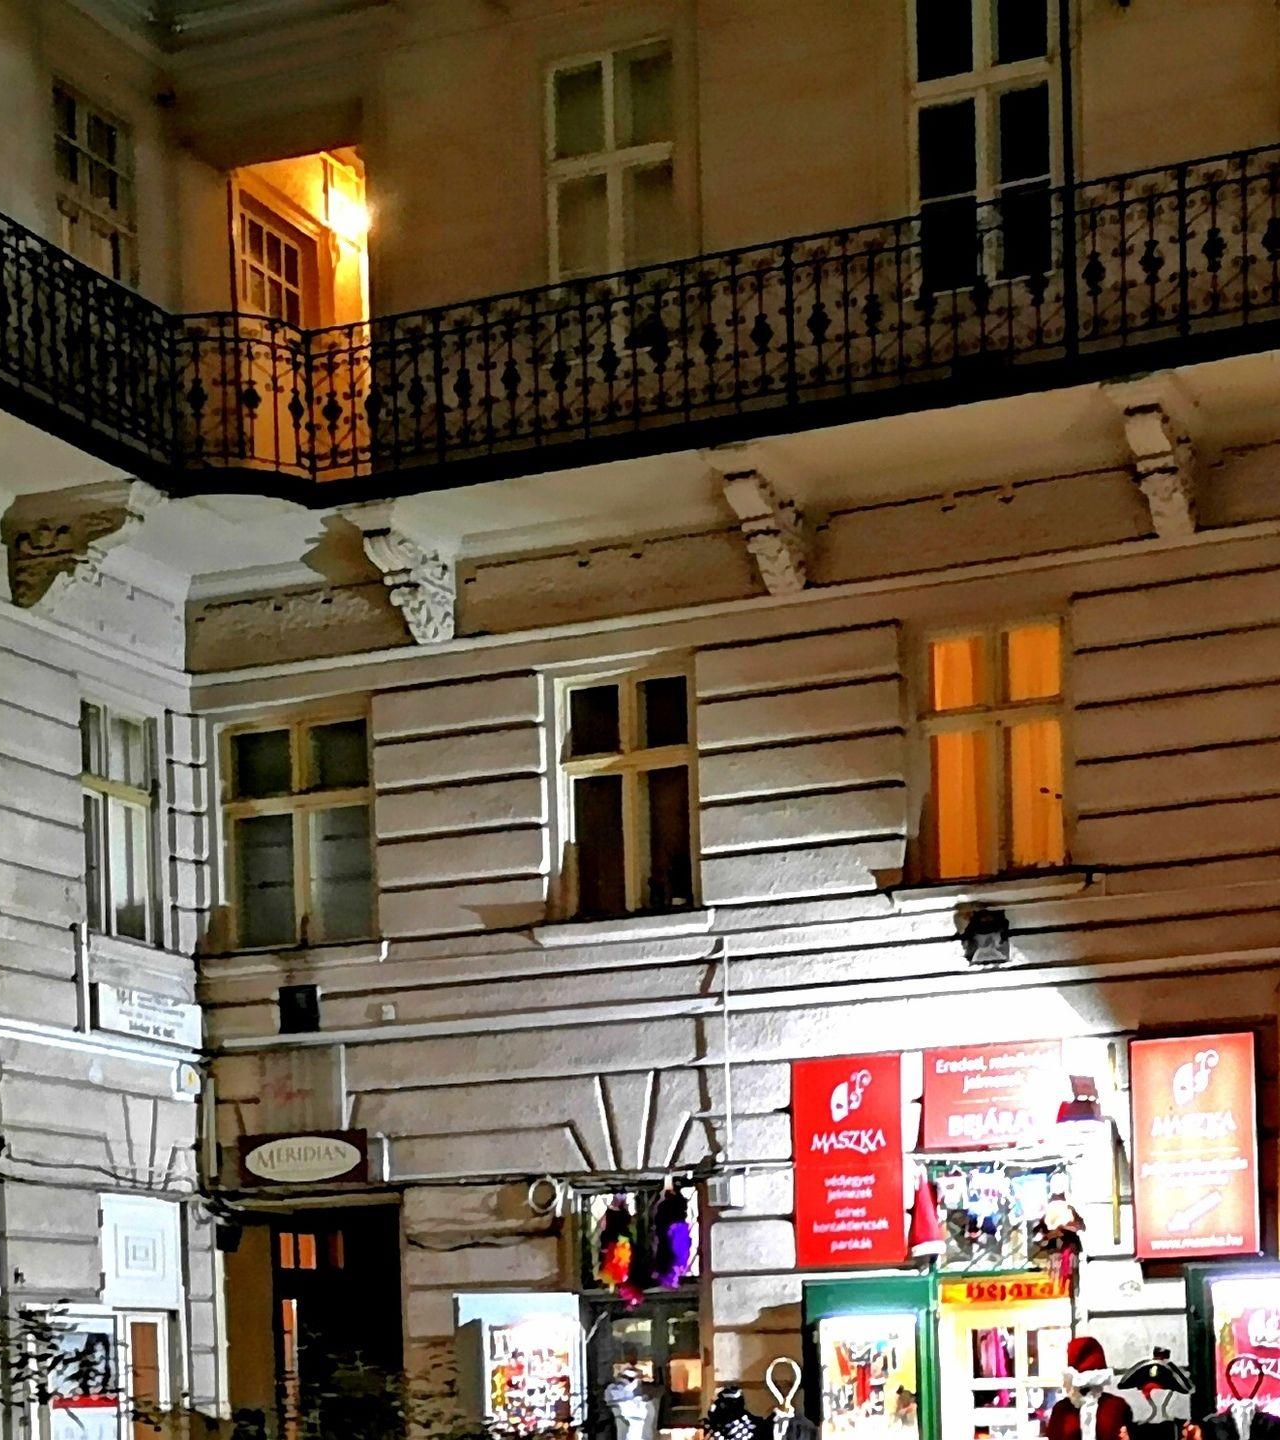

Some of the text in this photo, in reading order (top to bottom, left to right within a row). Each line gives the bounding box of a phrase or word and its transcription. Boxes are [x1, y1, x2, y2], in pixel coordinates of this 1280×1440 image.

[948, 1106, 1034, 1141] BEJÁRA
[810, 1129, 887, 1155] MASZKA
[256, 1146, 347, 1169] MERIDIAN
